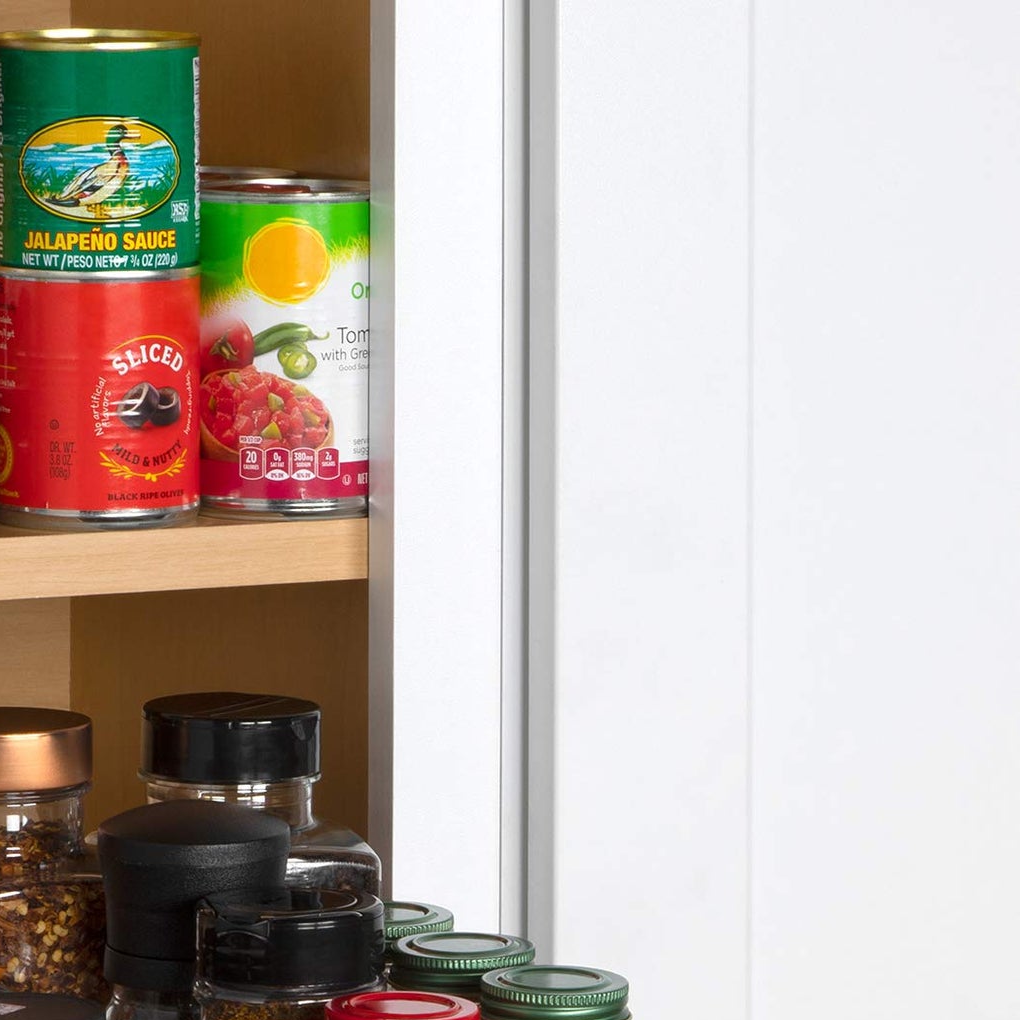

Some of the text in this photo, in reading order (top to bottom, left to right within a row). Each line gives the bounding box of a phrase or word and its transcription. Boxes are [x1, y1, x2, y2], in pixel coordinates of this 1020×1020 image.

[24, 227, 176, 251] JALAPEÑO SAUCE
[22, 252, 40, 266] NET
[142, 253, 153, 267] OZ
[111, 343, 184, 376] SLICED
[321, 348, 347, 362] with
[90, 376, 106, 437] No artificial
[101, 390, 112, 428] flavors
[111, 439, 183, 467] MILD & NUTTY
[245, 450, 258, 464] 20
[107, 488, 184, 501] BLACK RIPE OLIVES
